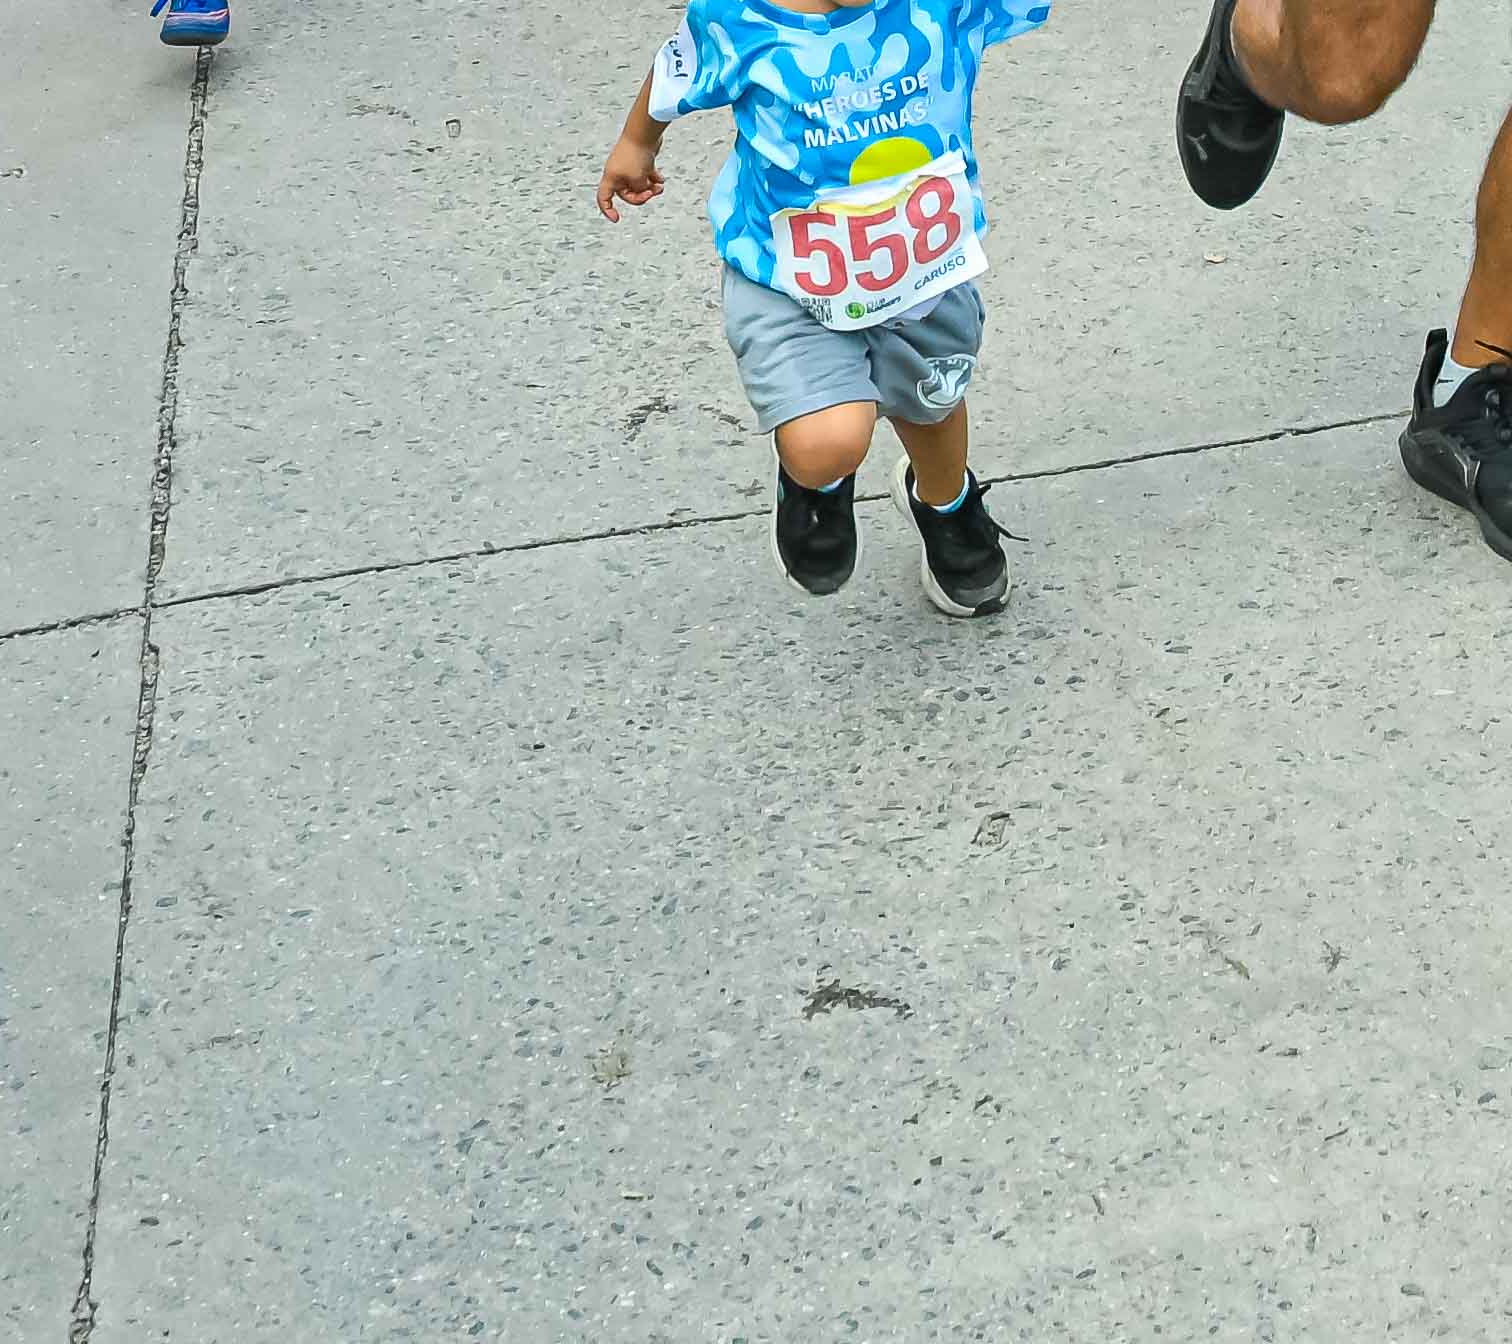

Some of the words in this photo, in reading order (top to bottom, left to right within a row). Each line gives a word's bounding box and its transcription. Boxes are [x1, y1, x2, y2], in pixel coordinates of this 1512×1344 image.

[899, 73, 929, 97] DE
[788, 176, 962, 298] 558
[913, 254, 968, 291] CARUSO
